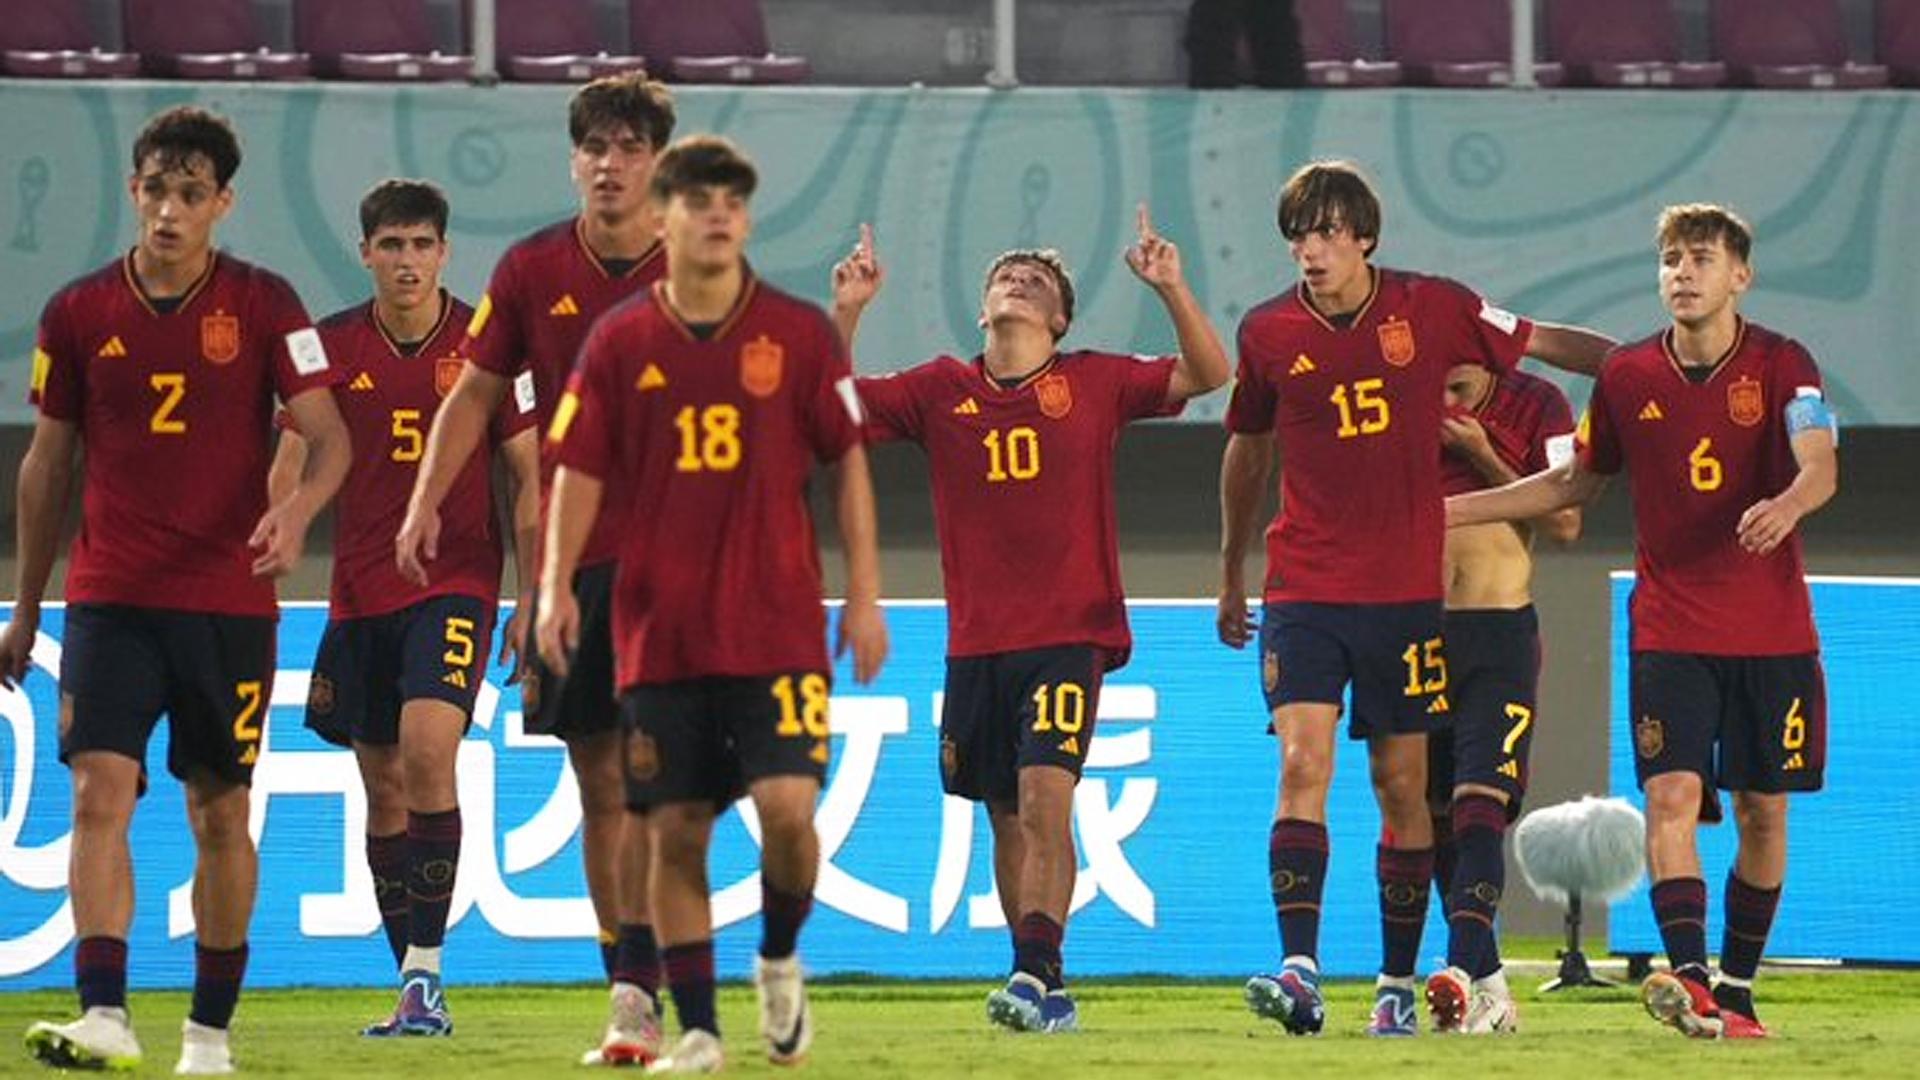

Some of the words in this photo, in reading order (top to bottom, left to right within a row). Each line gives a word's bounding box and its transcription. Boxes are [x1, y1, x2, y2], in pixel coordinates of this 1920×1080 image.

[150, 373, 186, 434] 2
[1331, 377, 1391, 439] 15
[391, 409, 425, 462] 5
[676, 403, 742, 472] 18
[983, 426, 1041, 482] 10
[1690, 437, 1723, 492] 6
[444, 617, 474, 667] 5
[1402, 637, 1447, 696] 15
[233, 681, 261, 741] 2
[771, 673, 830, 738] 18
[1032, 683, 1085, 734] 10
[1503, 703, 1531, 755] 7
[1783, 697, 1805, 751] 6
